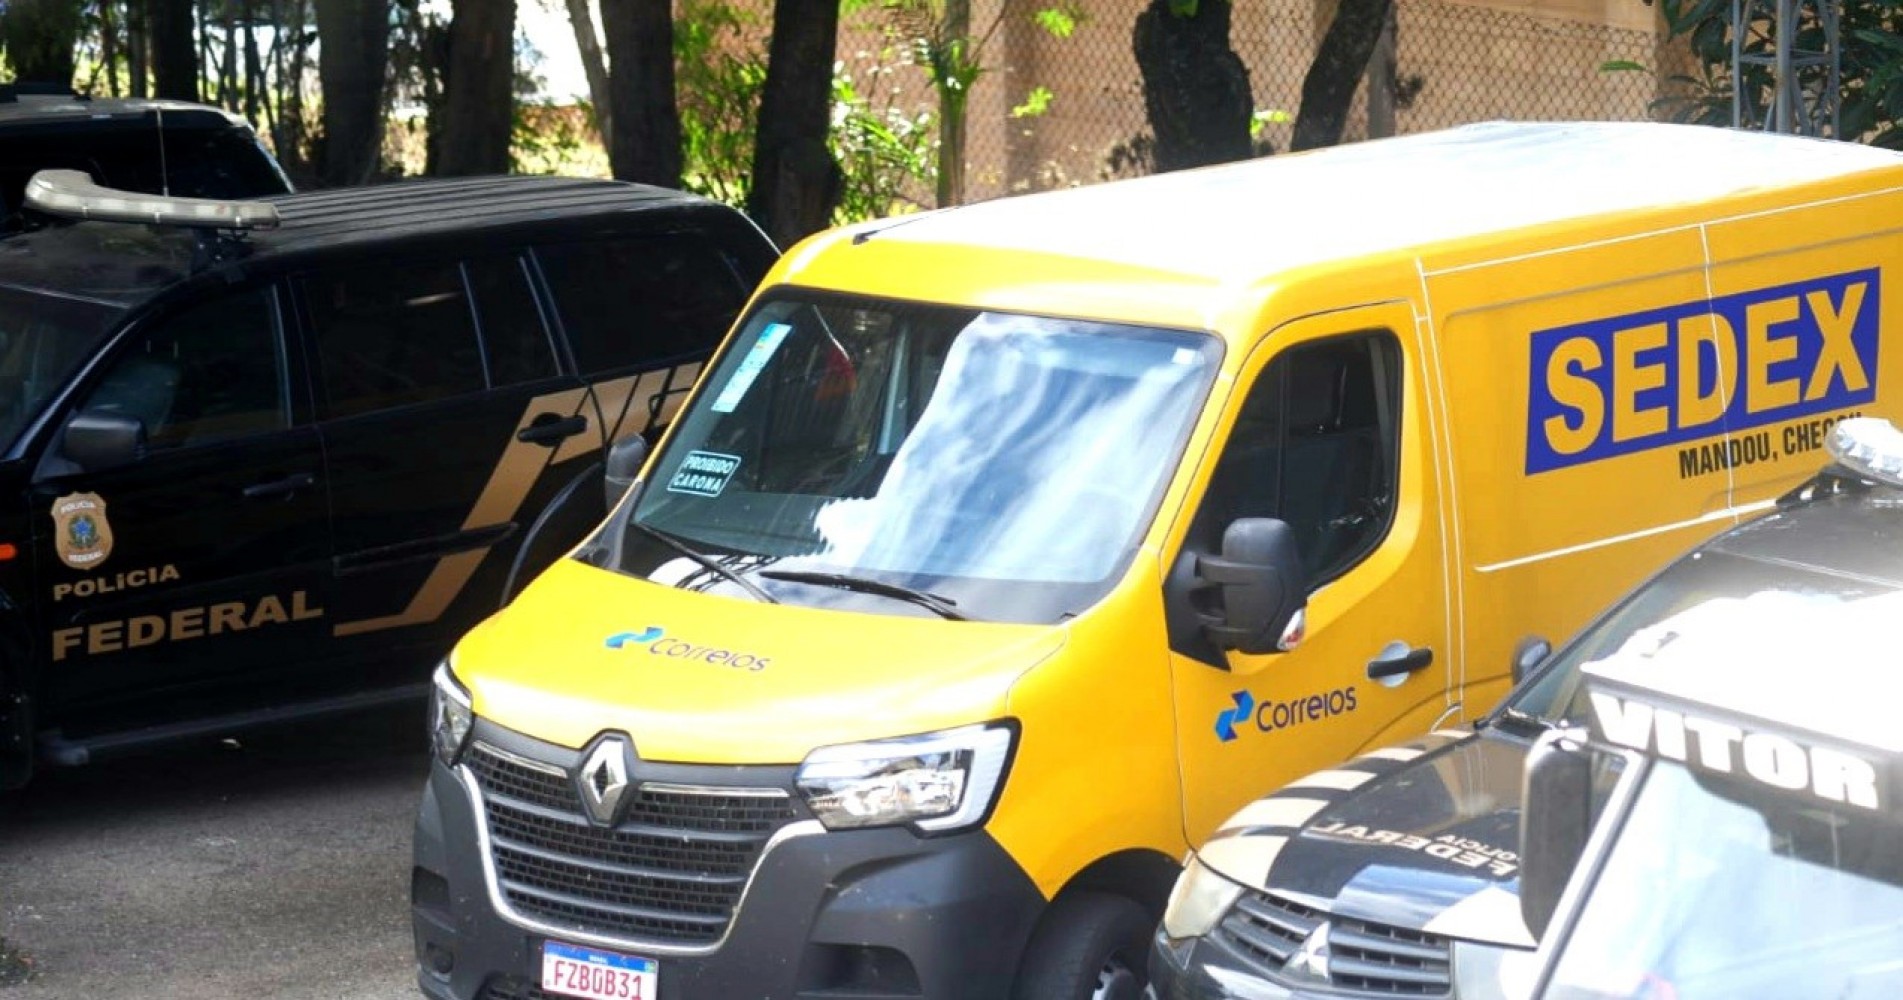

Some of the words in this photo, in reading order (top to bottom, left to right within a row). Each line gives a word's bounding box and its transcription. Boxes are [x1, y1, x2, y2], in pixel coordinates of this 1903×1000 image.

[1543, 281, 1869, 455] SEDEX
[684, 455, 734, 474] PROIBIDO
[1678, 427, 1779, 479] MANDOU,
[1783, 411, 1863, 455] CHE
[673, 472, 722, 492] CARONA
[53, 590, 324, 662] FEDERAL
[649, 638, 770, 671] Correios
[1256, 686, 1357, 732] Correios
[1589, 690, 1879, 810] VITOR
